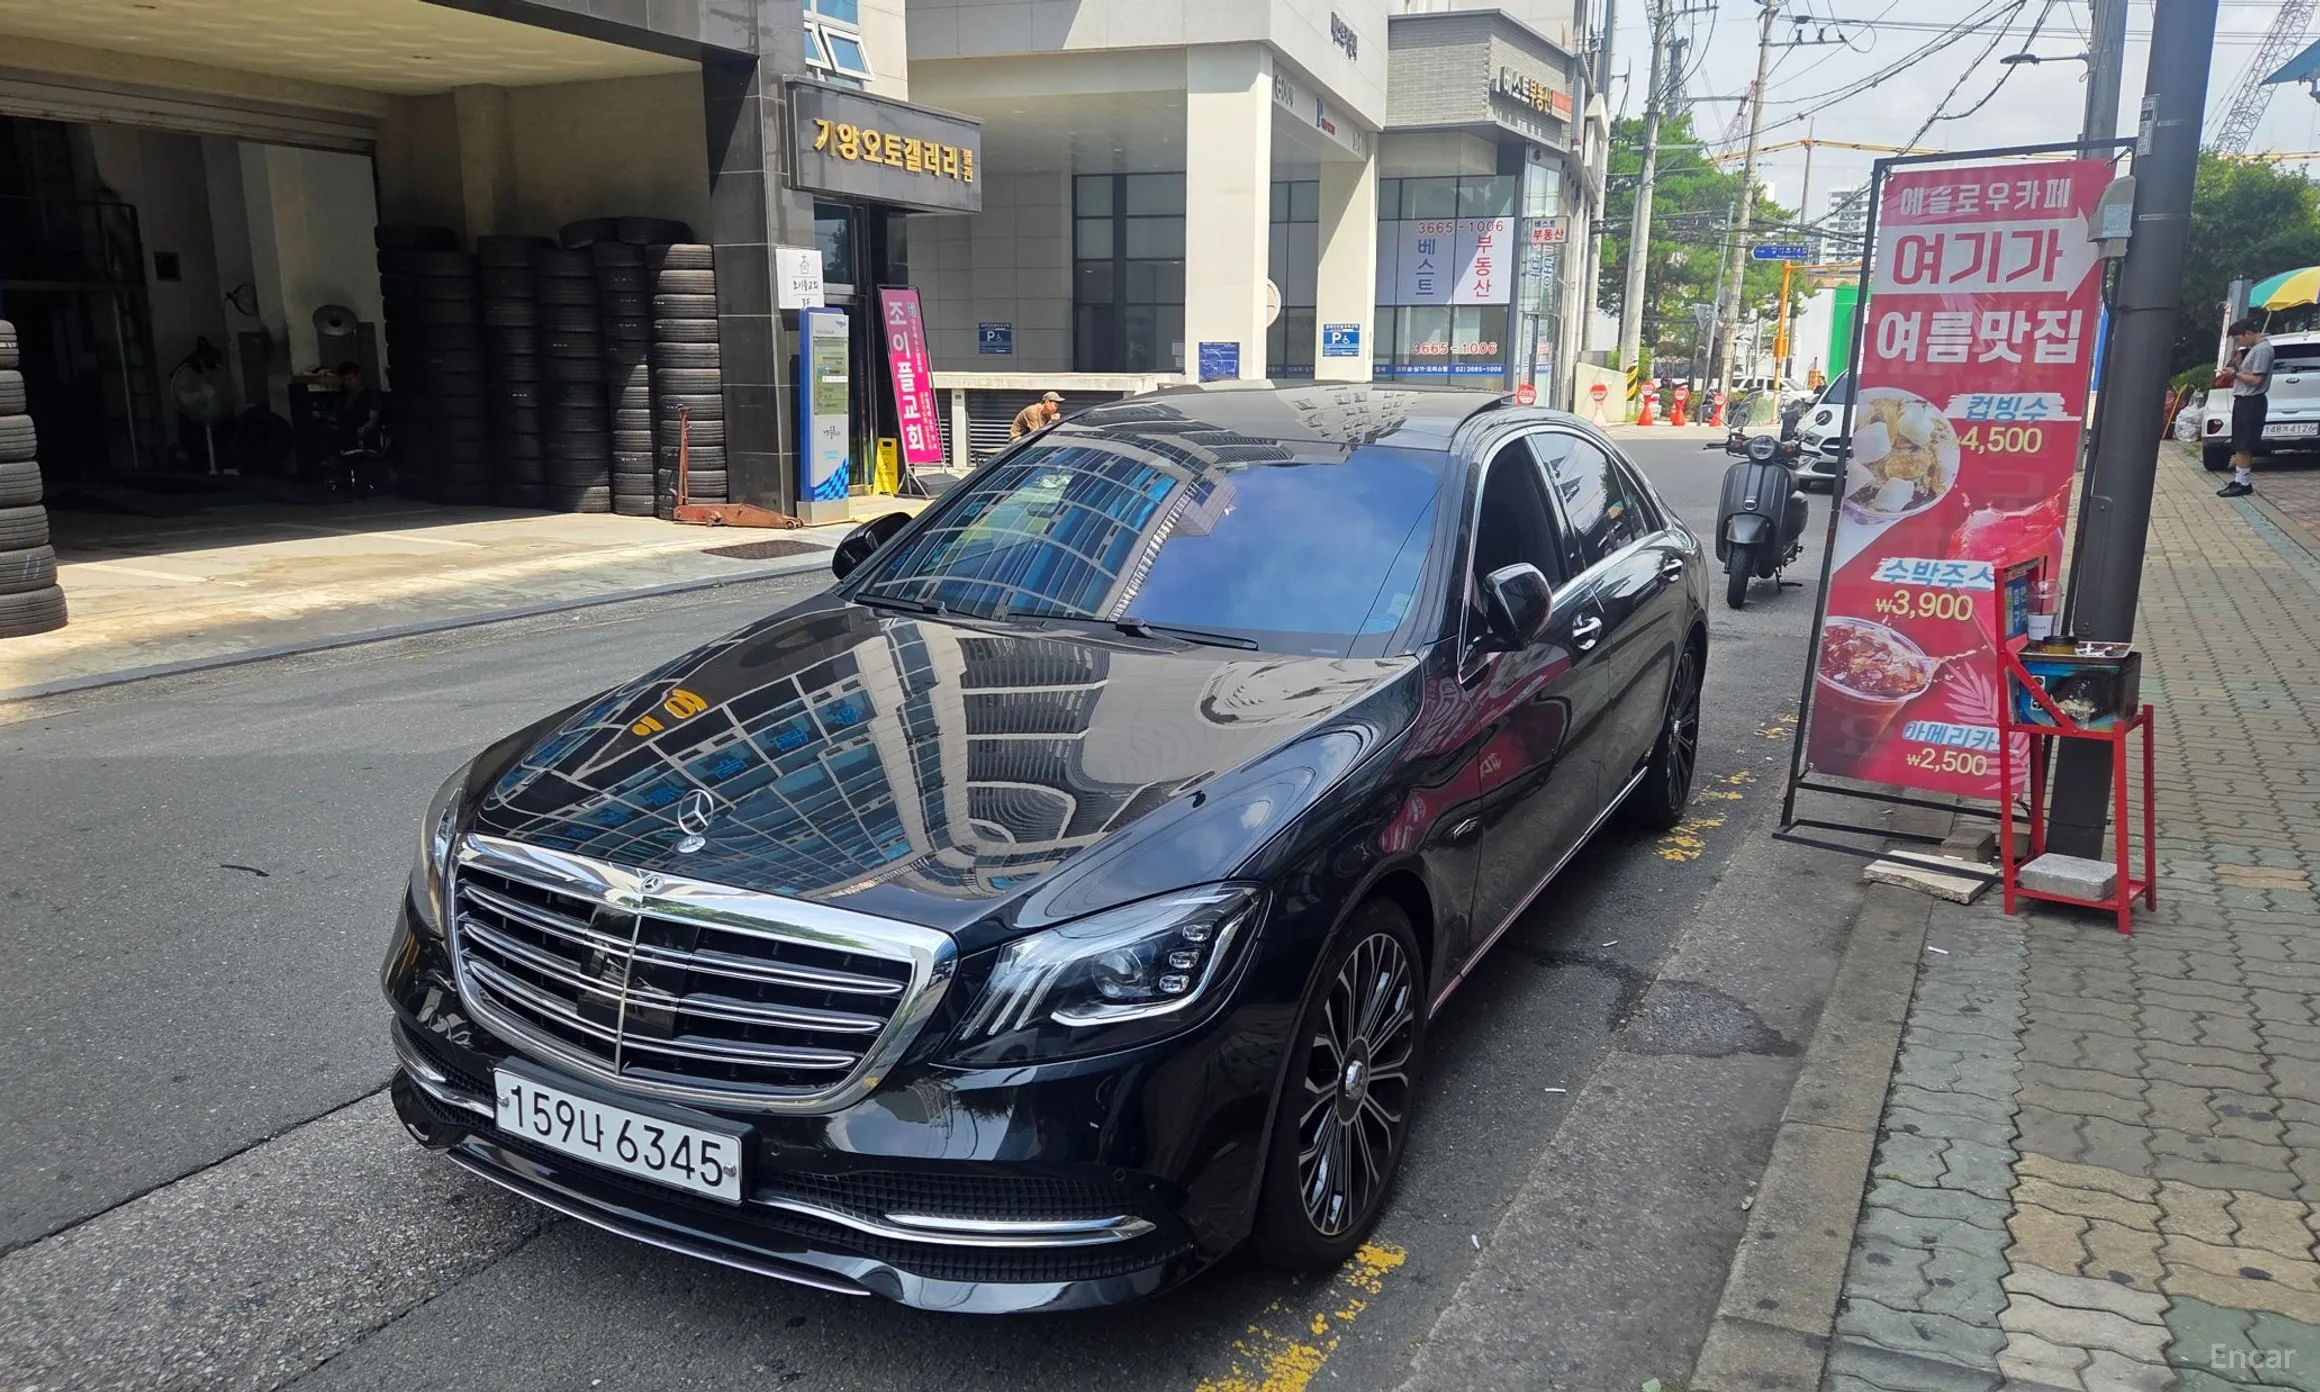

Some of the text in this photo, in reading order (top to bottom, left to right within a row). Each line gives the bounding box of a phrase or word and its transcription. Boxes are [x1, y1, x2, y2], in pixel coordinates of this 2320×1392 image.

[812, 118, 958, 179] 기양오토갤러리
[1900, 178, 2071, 216] 에슬로우카페
[1418, 221, 1504, 234] 3665-1006
[1533, 228, 1564, 241] 부동산
[1415, 238, 1436, 295] 베스트
[1473, 235, 1493, 297] 부동산
[1892, 228, 2063, 285] 여기가
[1413, 341, 1498, 356] 3665-1006
[1877, 309, 2083, 364] 여름맛집
[889, 301, 925, 451] 조이플교회
[1967, 396, 2049, 423] 컵빙수
[1958, 425, 2043, 455] 4,500
[1883, 560, 1995, 591] 수박주스
[1875, 589, 1974, 621] ₩3,900
[1902, 720, 2001, 753] 아메리카
[1906, 747, 1988, 776] ₩2,500
[510, 1085, 723, 1187] 159나 6345
